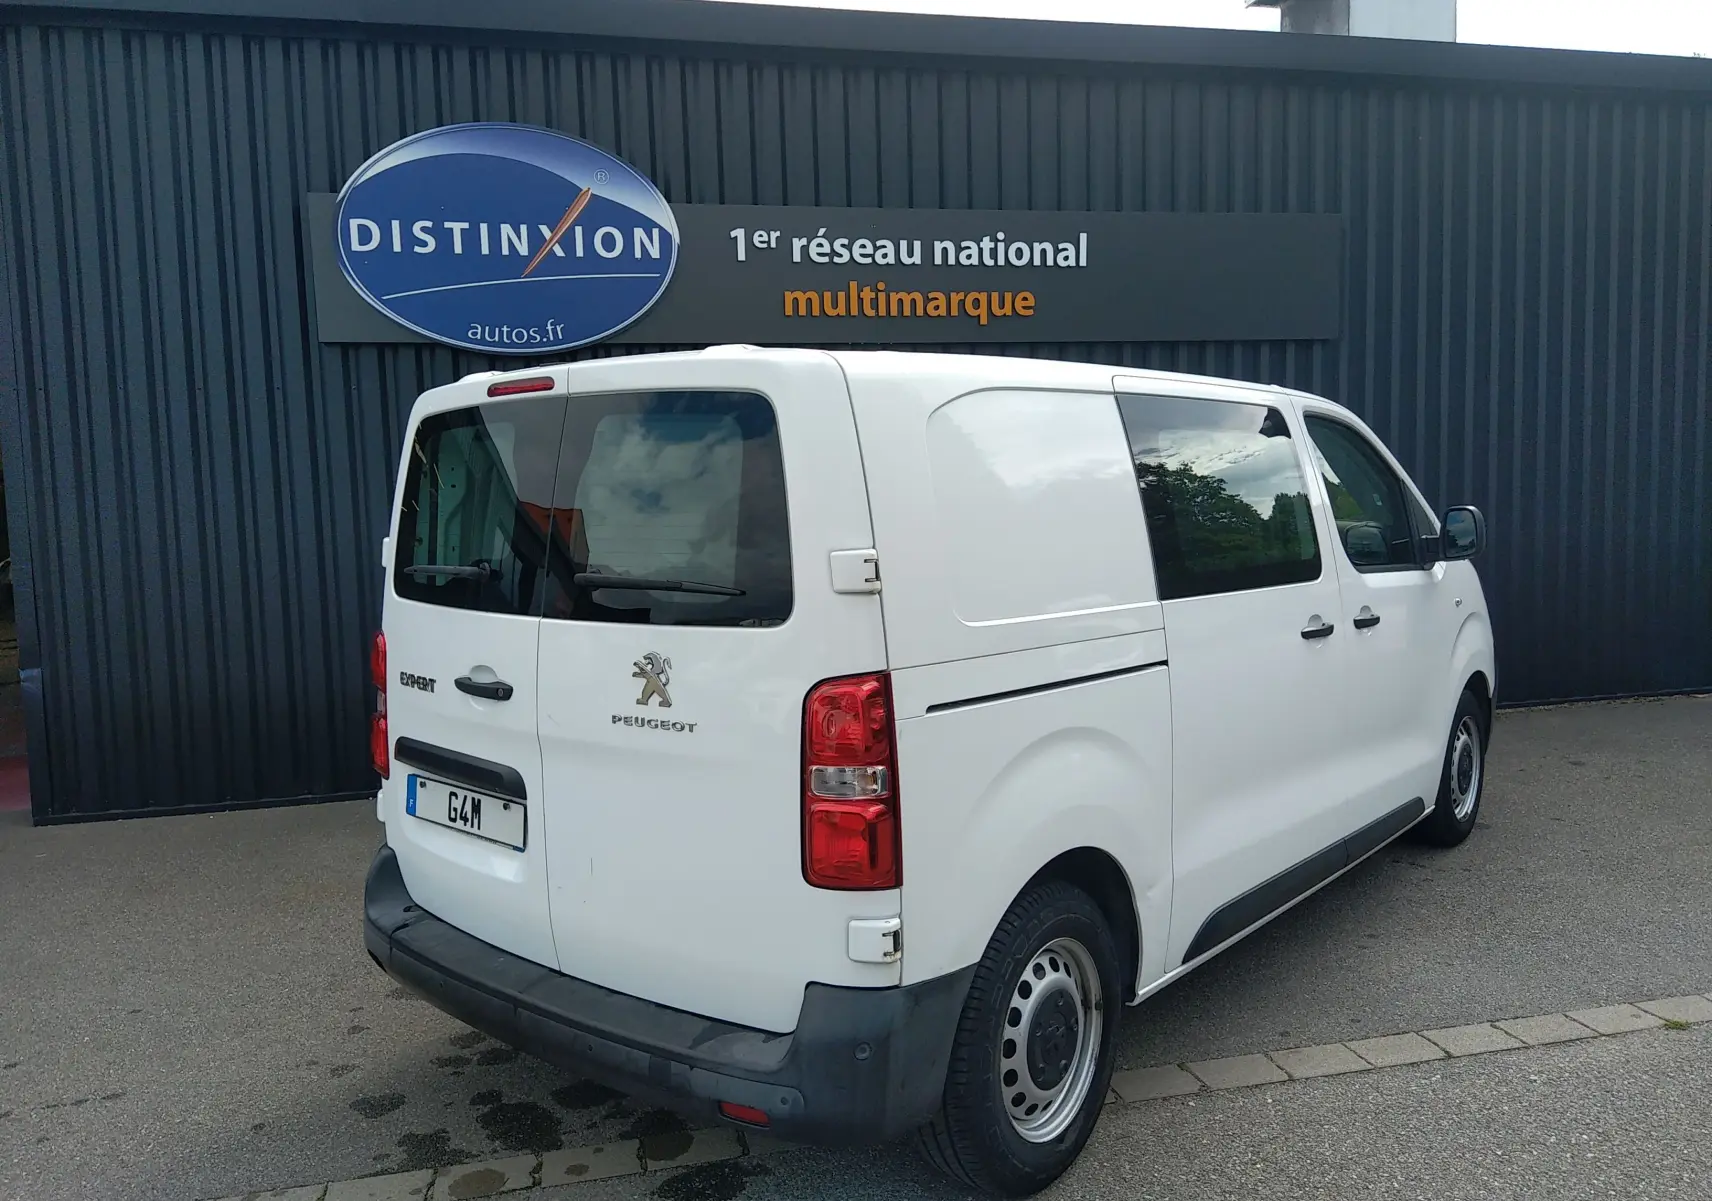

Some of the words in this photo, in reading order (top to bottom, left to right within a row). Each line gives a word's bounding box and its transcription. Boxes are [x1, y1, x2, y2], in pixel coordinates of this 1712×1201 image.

[348, 217, 661, 260] DISTINXION
[729, 227, 781, 262] 1er
[791, 227, 922, 266] réseau
[933, 231, 1088, 267] national
[783, 280, 1036, 326] multimarque
[467, 319, 565, 344] autos.fr
[400, 671, 436, 693] EXPERT
[611, 714, 698, 733] PEUGEOT
[448, 790, 481, 831] G4M
